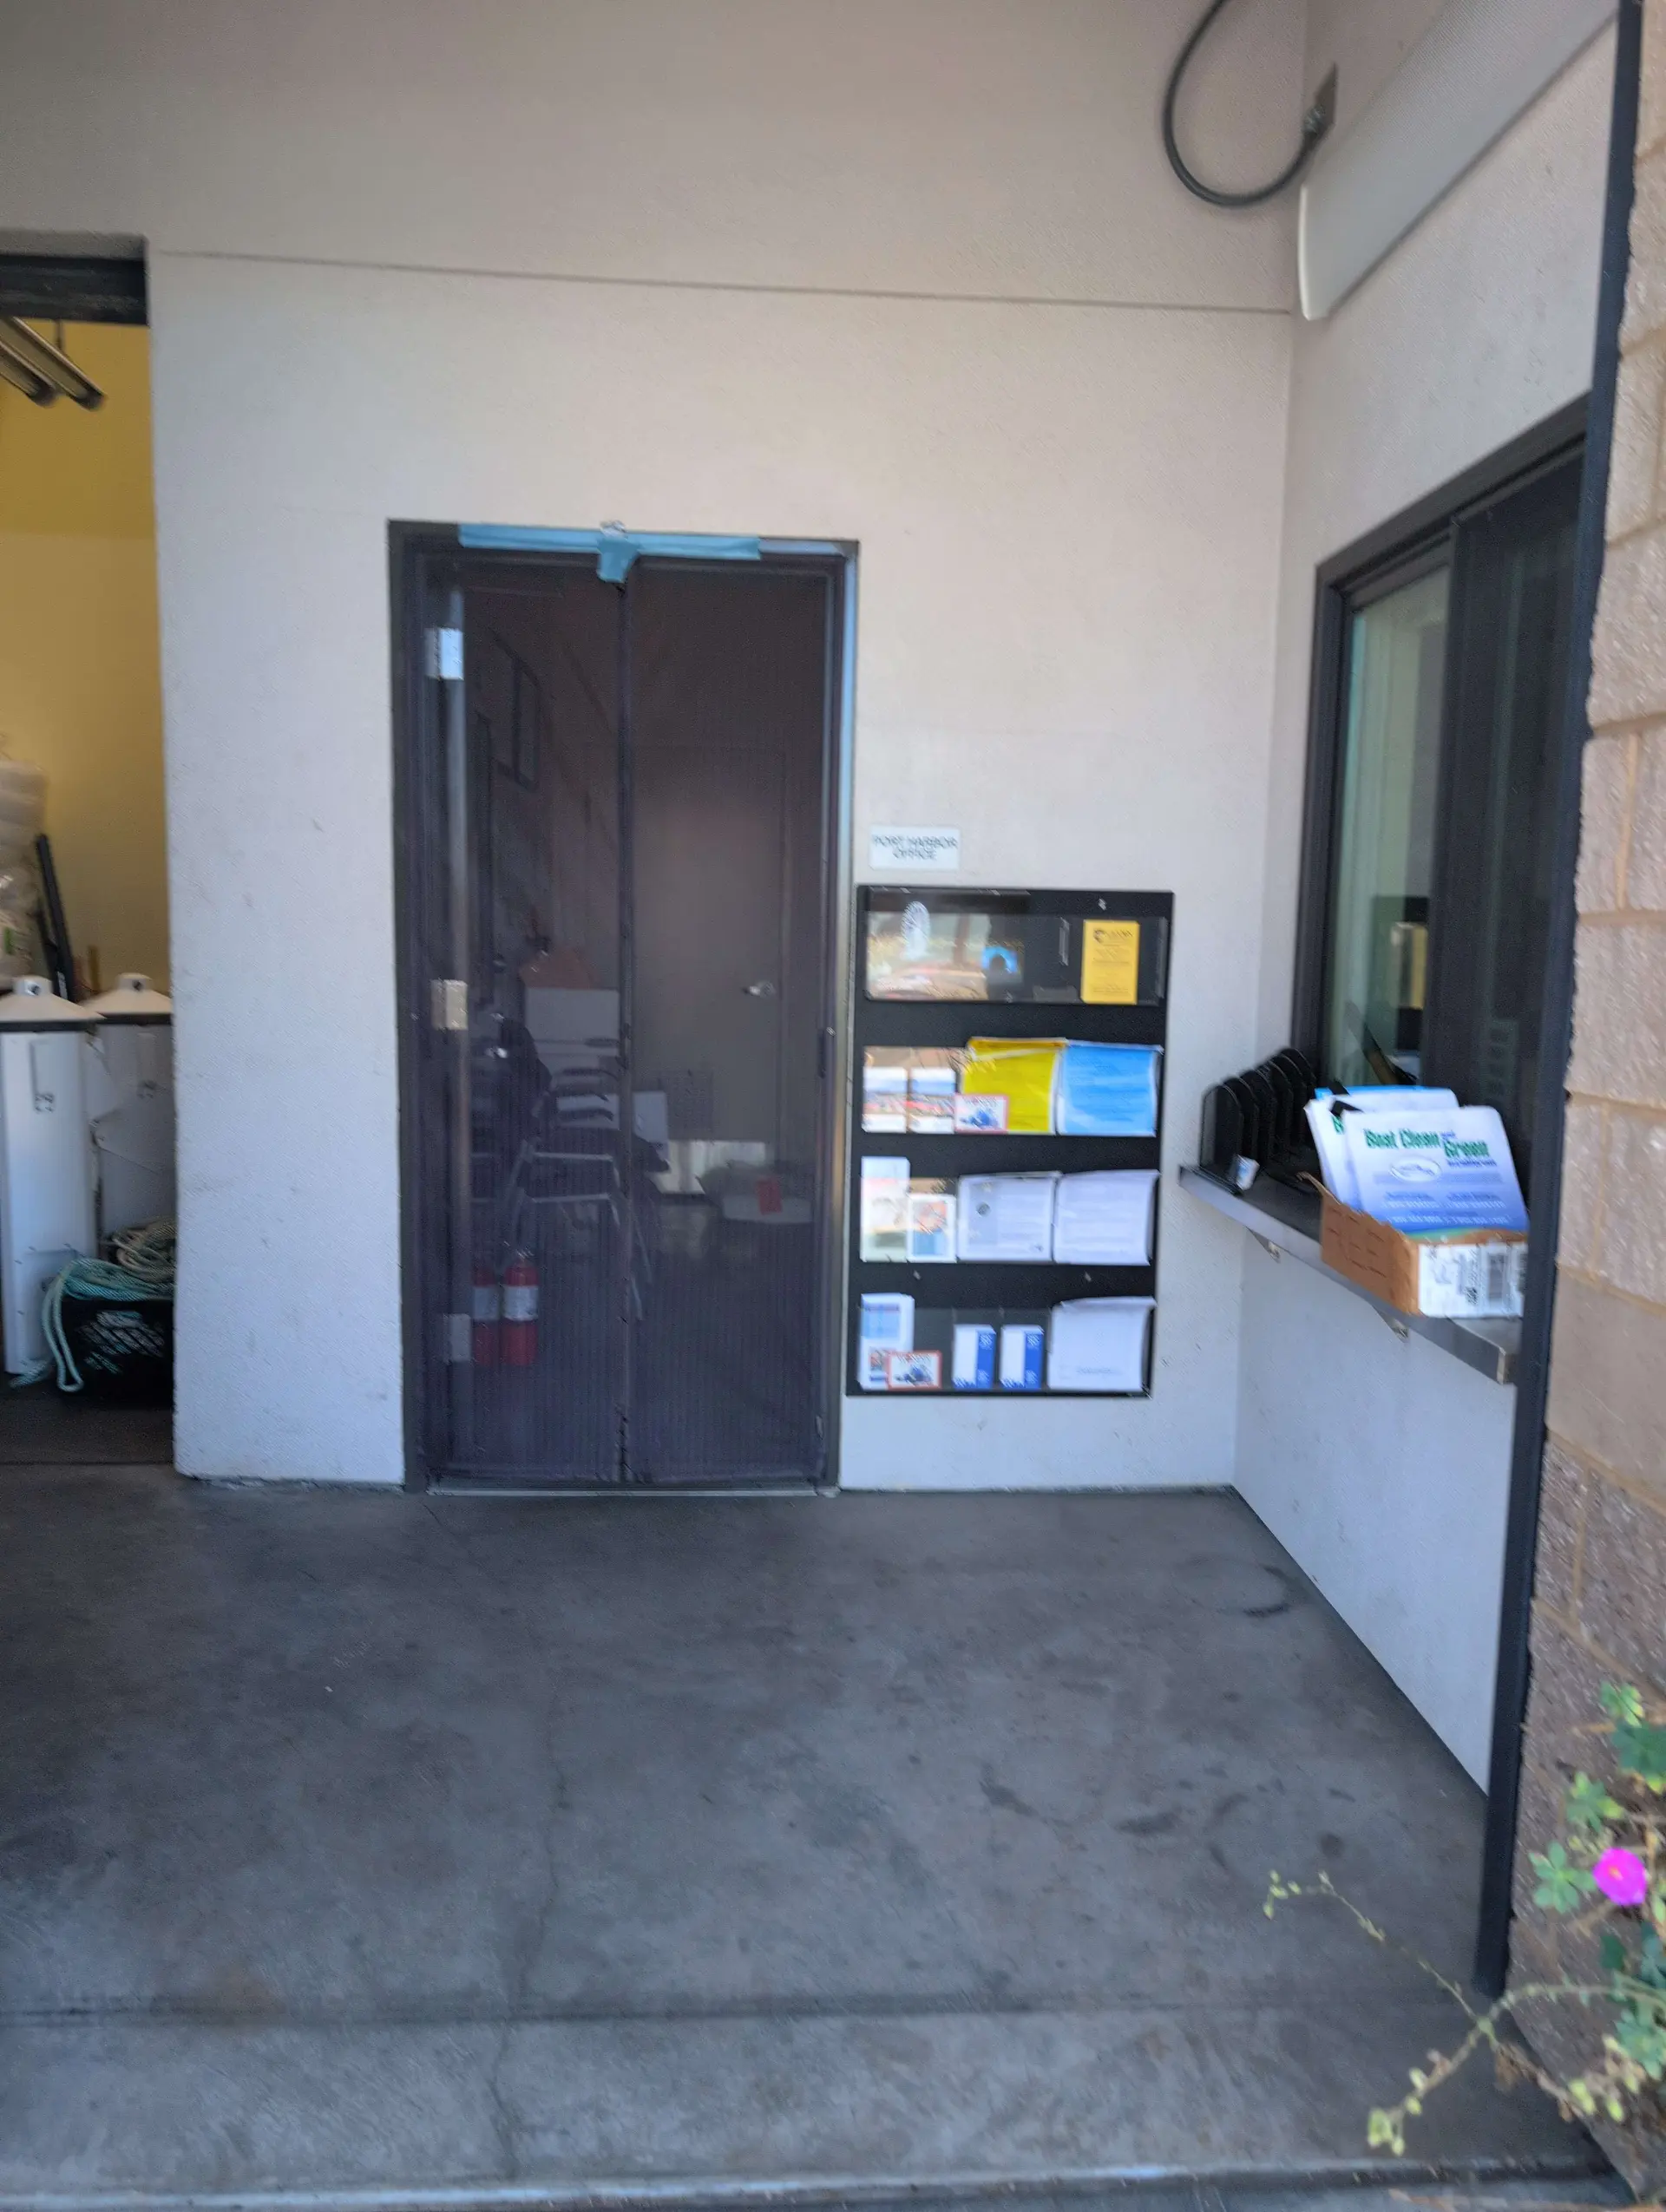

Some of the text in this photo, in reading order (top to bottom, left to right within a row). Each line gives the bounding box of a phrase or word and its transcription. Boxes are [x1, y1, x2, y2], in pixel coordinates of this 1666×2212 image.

[871, 834, 958, 849] PORT HARBOR
[892, 847, 937, 860] OFFICE
[1443, 1140, 1490, 1158] Green
